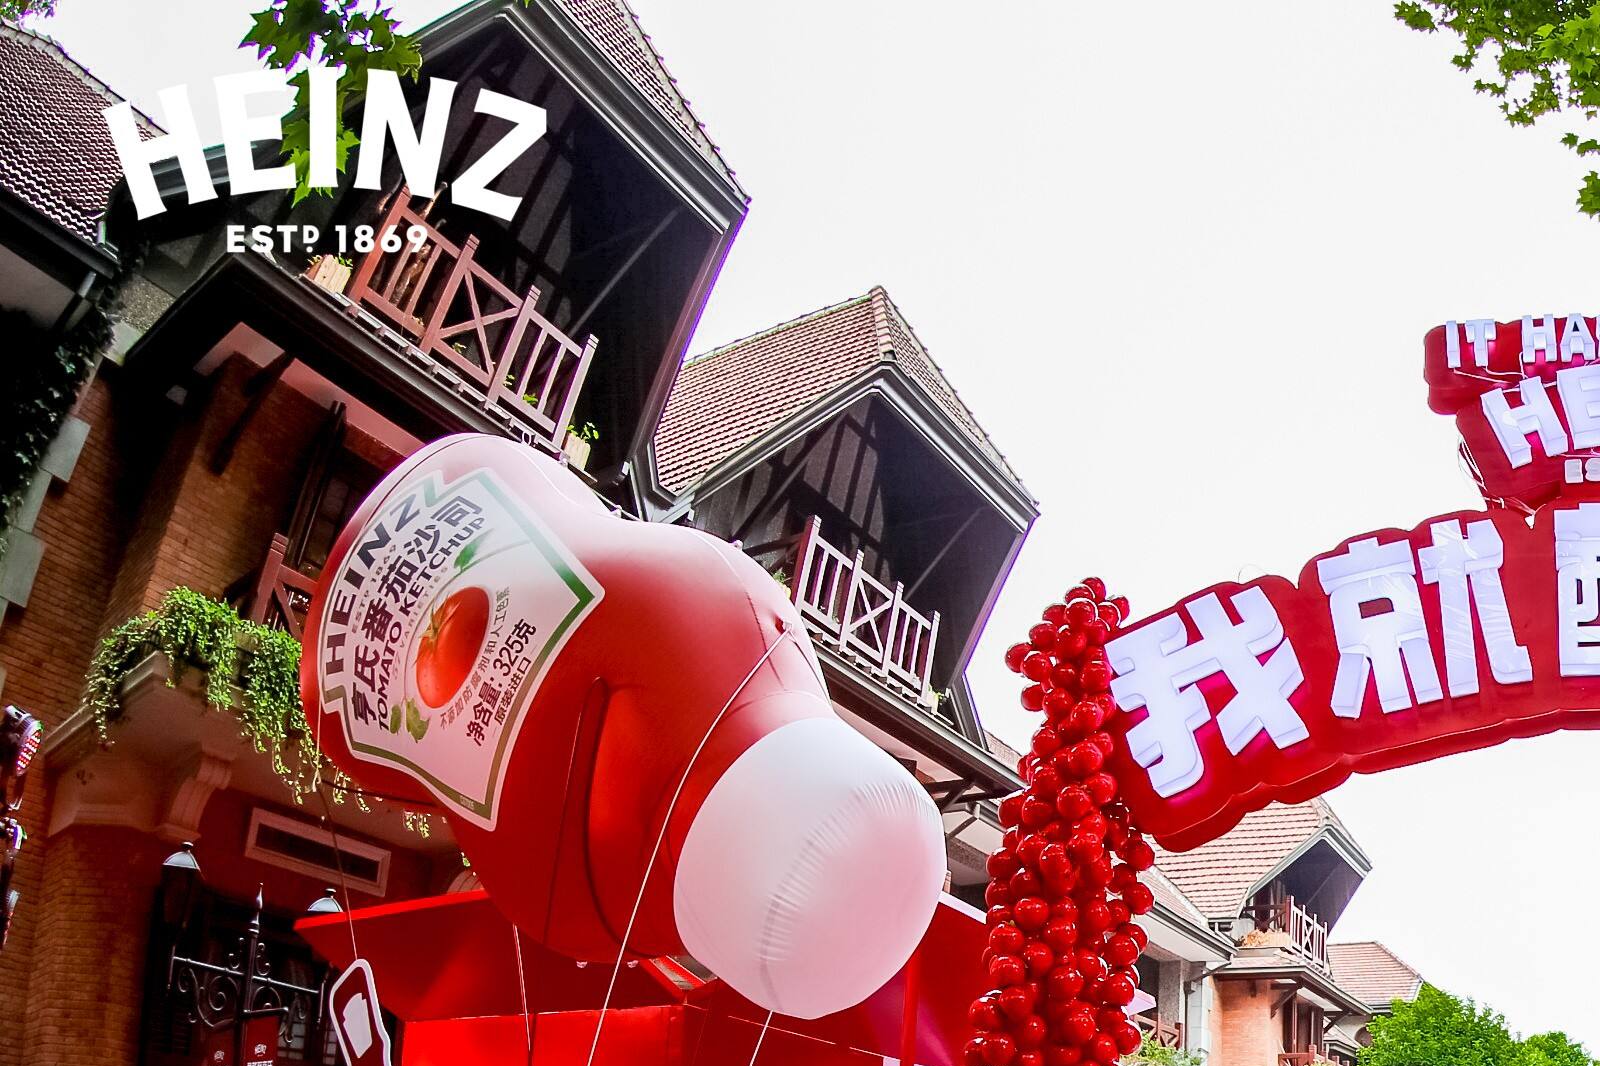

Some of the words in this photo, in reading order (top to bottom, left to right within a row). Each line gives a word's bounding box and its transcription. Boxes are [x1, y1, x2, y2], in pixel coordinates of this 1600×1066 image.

[1446, 319, 1496, 368] IT
[326, 493, 420, 675] HEINZ
[352, 496, 483, 725] 亨氏番茄沙司
[377, 621, 402, 731] TOMATO
[399, 517, 485, 617] KETCHUP
[494, 656, 532, 726] 原装进口
